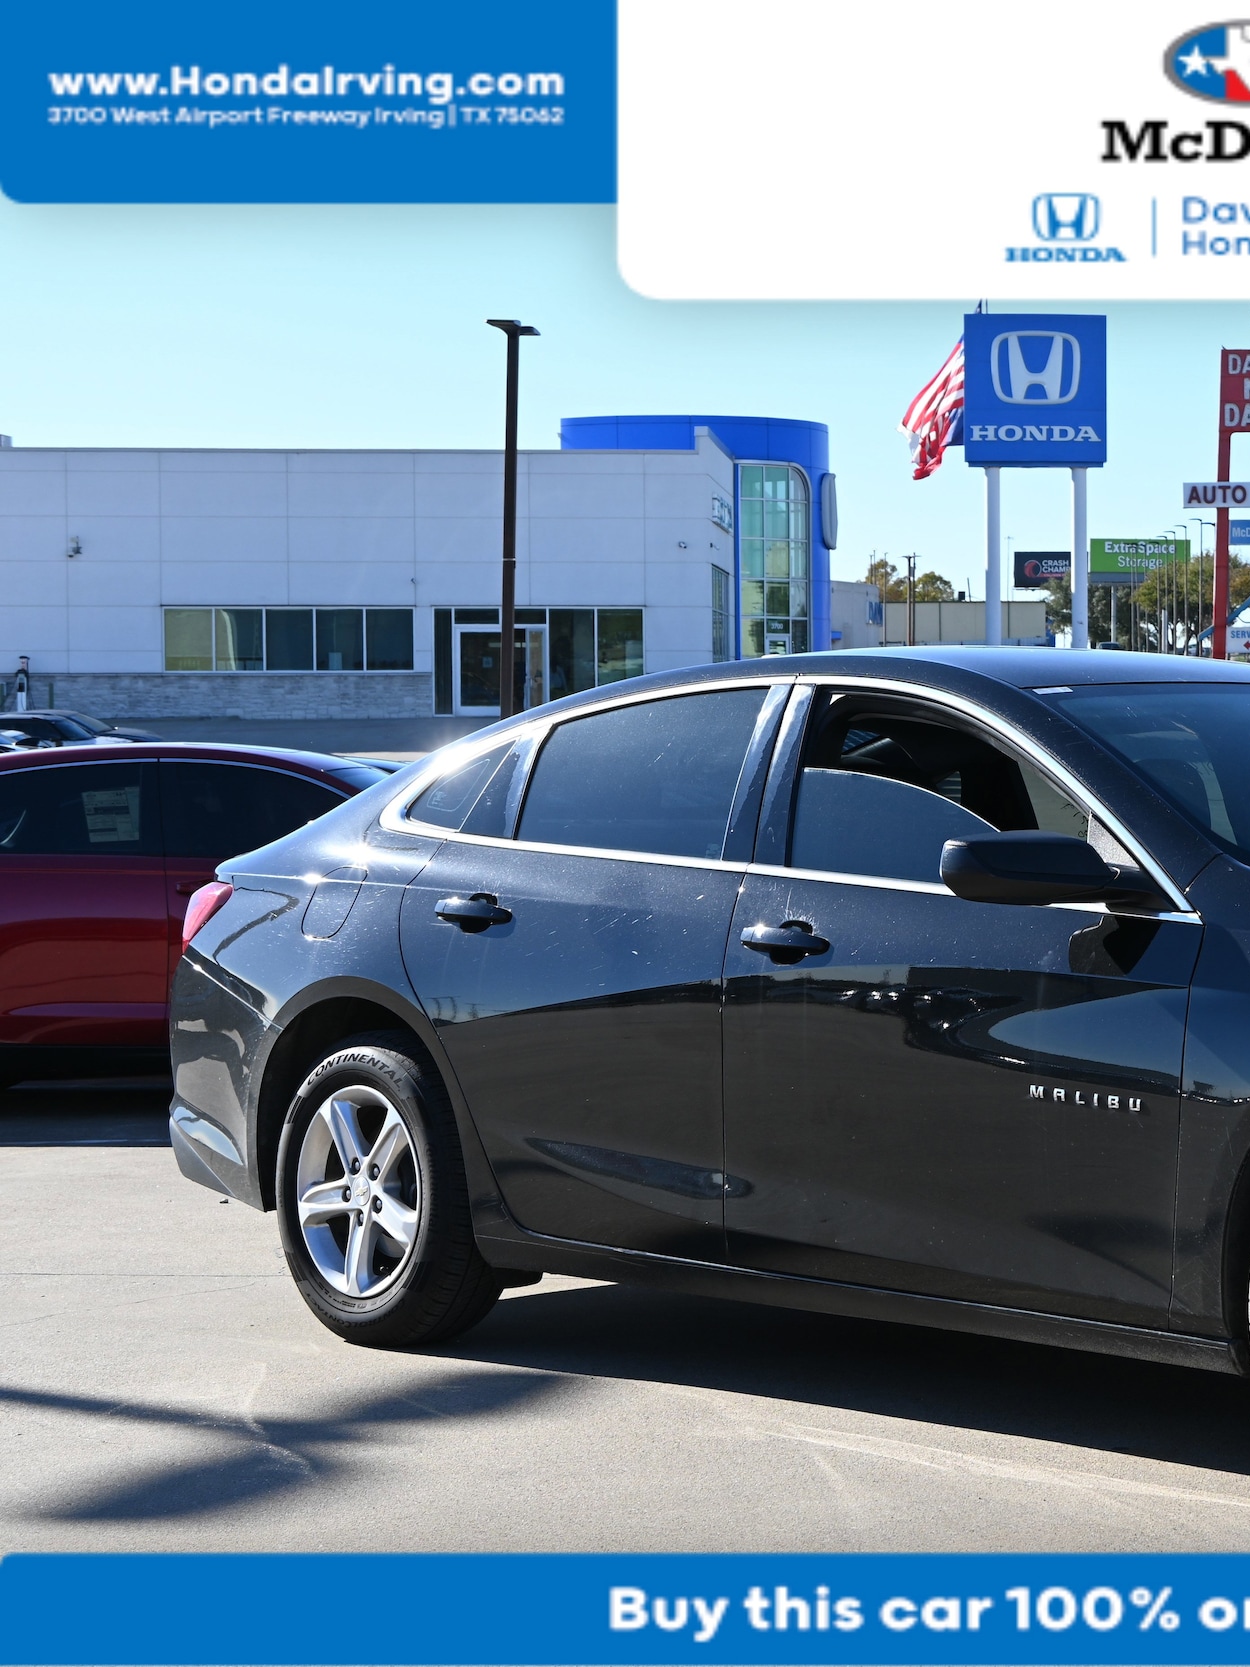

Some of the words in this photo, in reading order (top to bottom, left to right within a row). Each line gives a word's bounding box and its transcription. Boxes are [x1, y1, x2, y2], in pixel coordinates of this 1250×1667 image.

[970, 425, 1101, 442] HONDA
[1188, 485, 1247, 504] AUTO
[1117, 556, 1163, 569] Storage
[306, 1053, 403, 1090] CONTINENTAL
[1029, 1084, 1142, 1112] MALIBU
